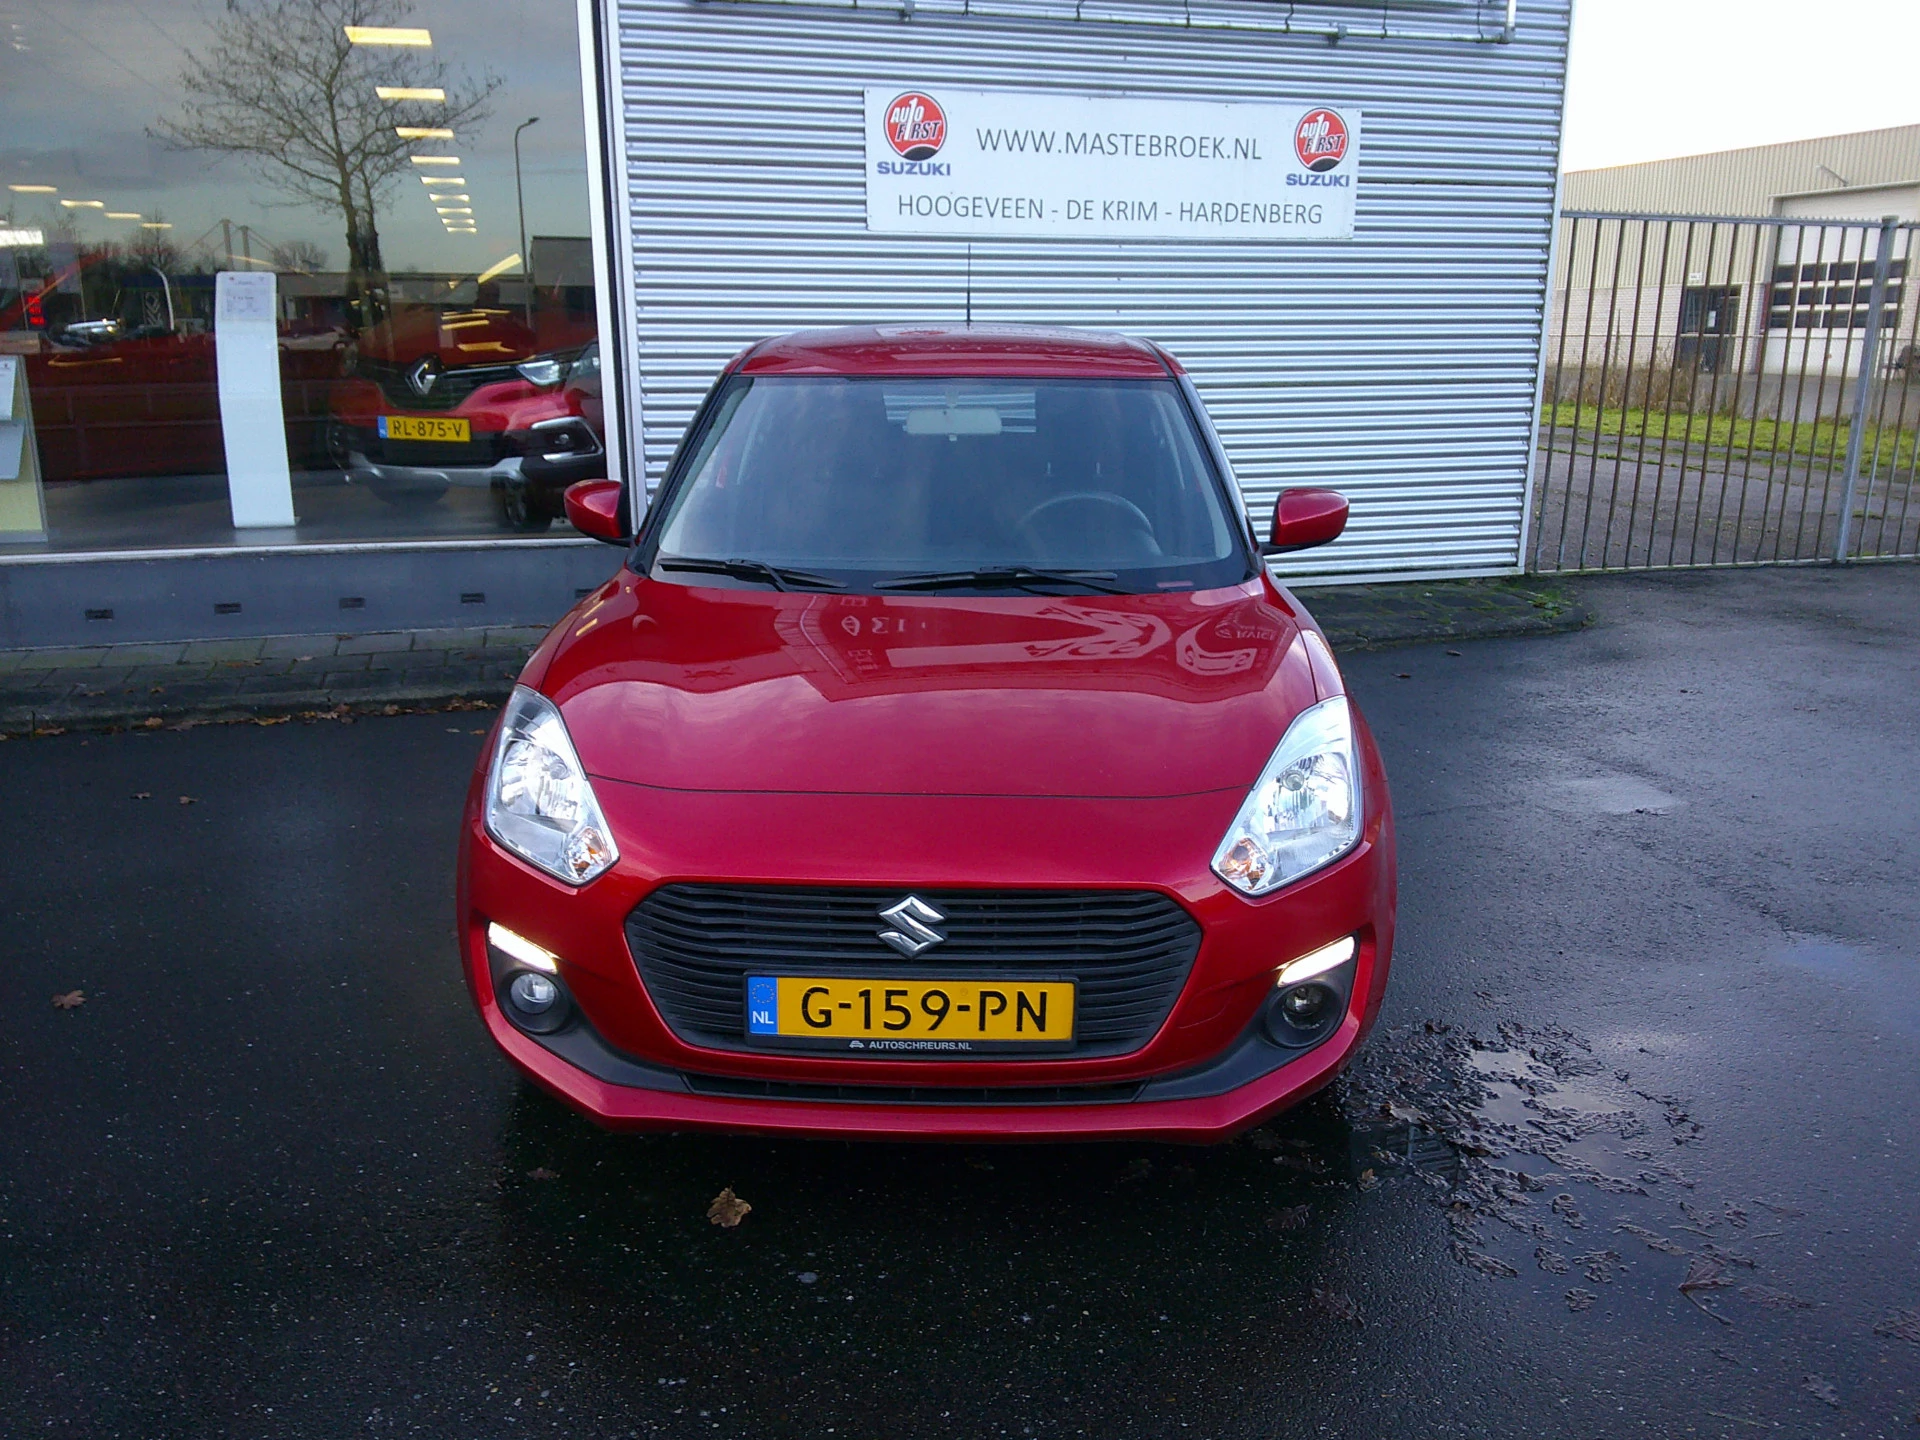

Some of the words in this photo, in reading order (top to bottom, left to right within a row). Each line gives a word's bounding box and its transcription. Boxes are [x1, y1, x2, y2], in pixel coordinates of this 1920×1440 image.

[976, 128, 1262, 160] WWW.MASTEBROEK.NL
[877, 161, 951, 176] SUZUKI
[1286, 173, 1350, 187] SUZUKI
[899, 194, 1043, 219] HOOGEVEEN
[1067, 199, 1094, 220] DE
[1103, 200, 1157, 221] KRIM
[1179, 202, 1323, 224] HARDENBERG
[393, 420, 462, 438] RL-875-V
[752, 1010, 774, 1024] NL
[801, 986, 1048, 1033] G-159-PN
[869, 1040, 972, 1050] AUTOSCHREURS.NL
